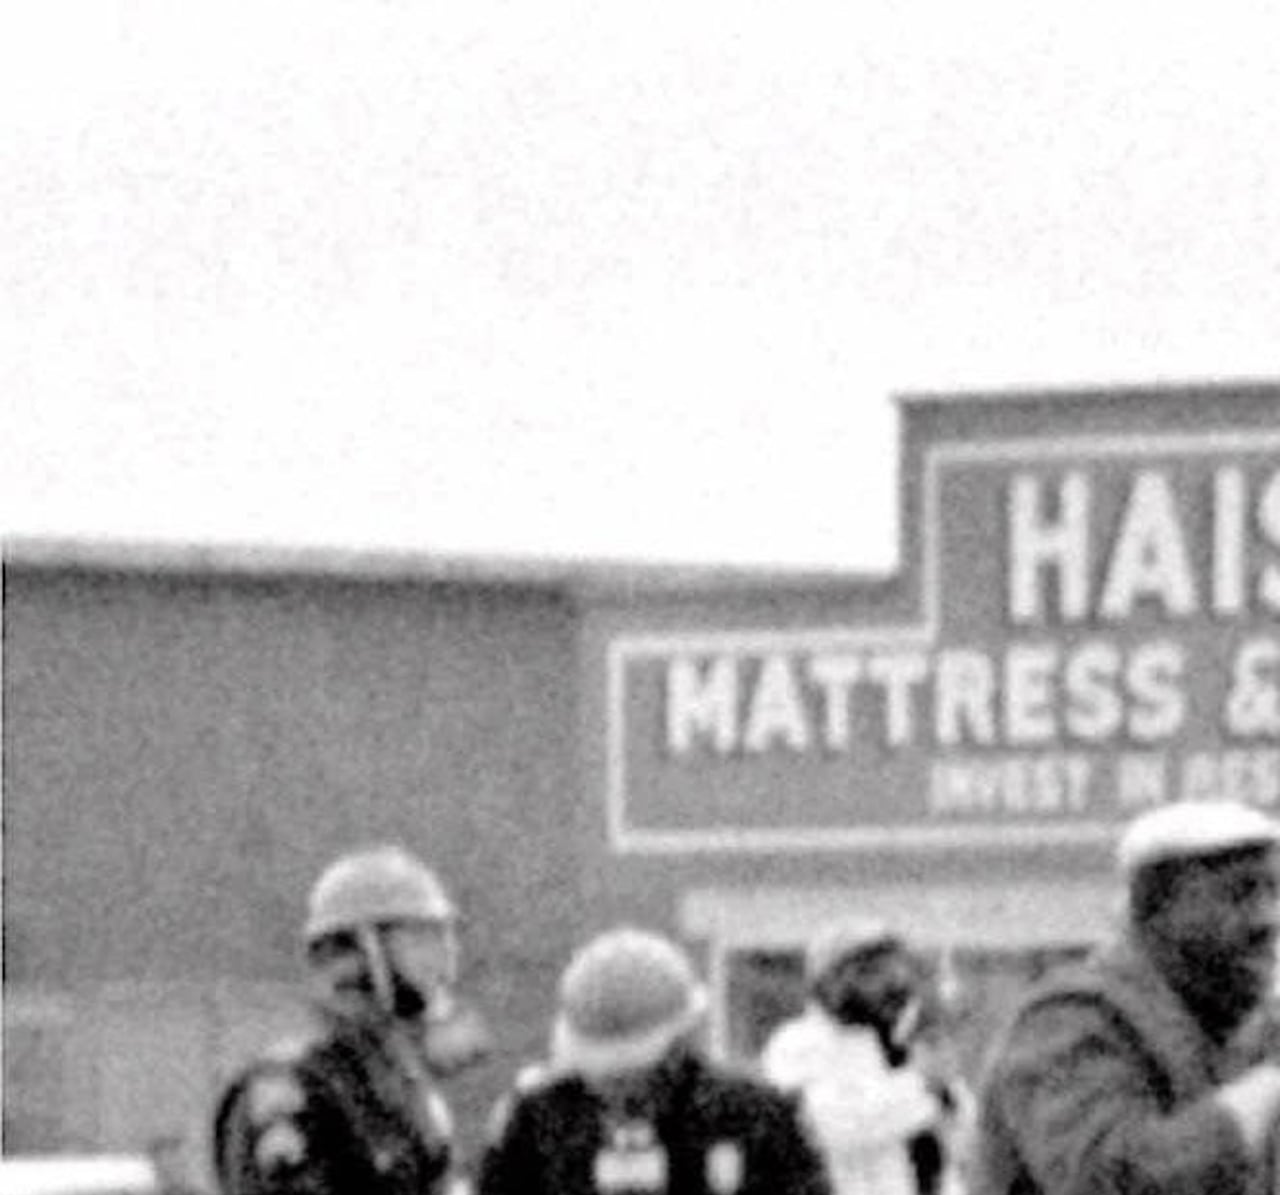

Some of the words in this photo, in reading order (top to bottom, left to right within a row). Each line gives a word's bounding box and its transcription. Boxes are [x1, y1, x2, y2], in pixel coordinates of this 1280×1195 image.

[668, 644, 1185, 750] MATTRESS
[931, 759, 1090, 810] INVEST
[1120, 753, 1164, 803] IN
